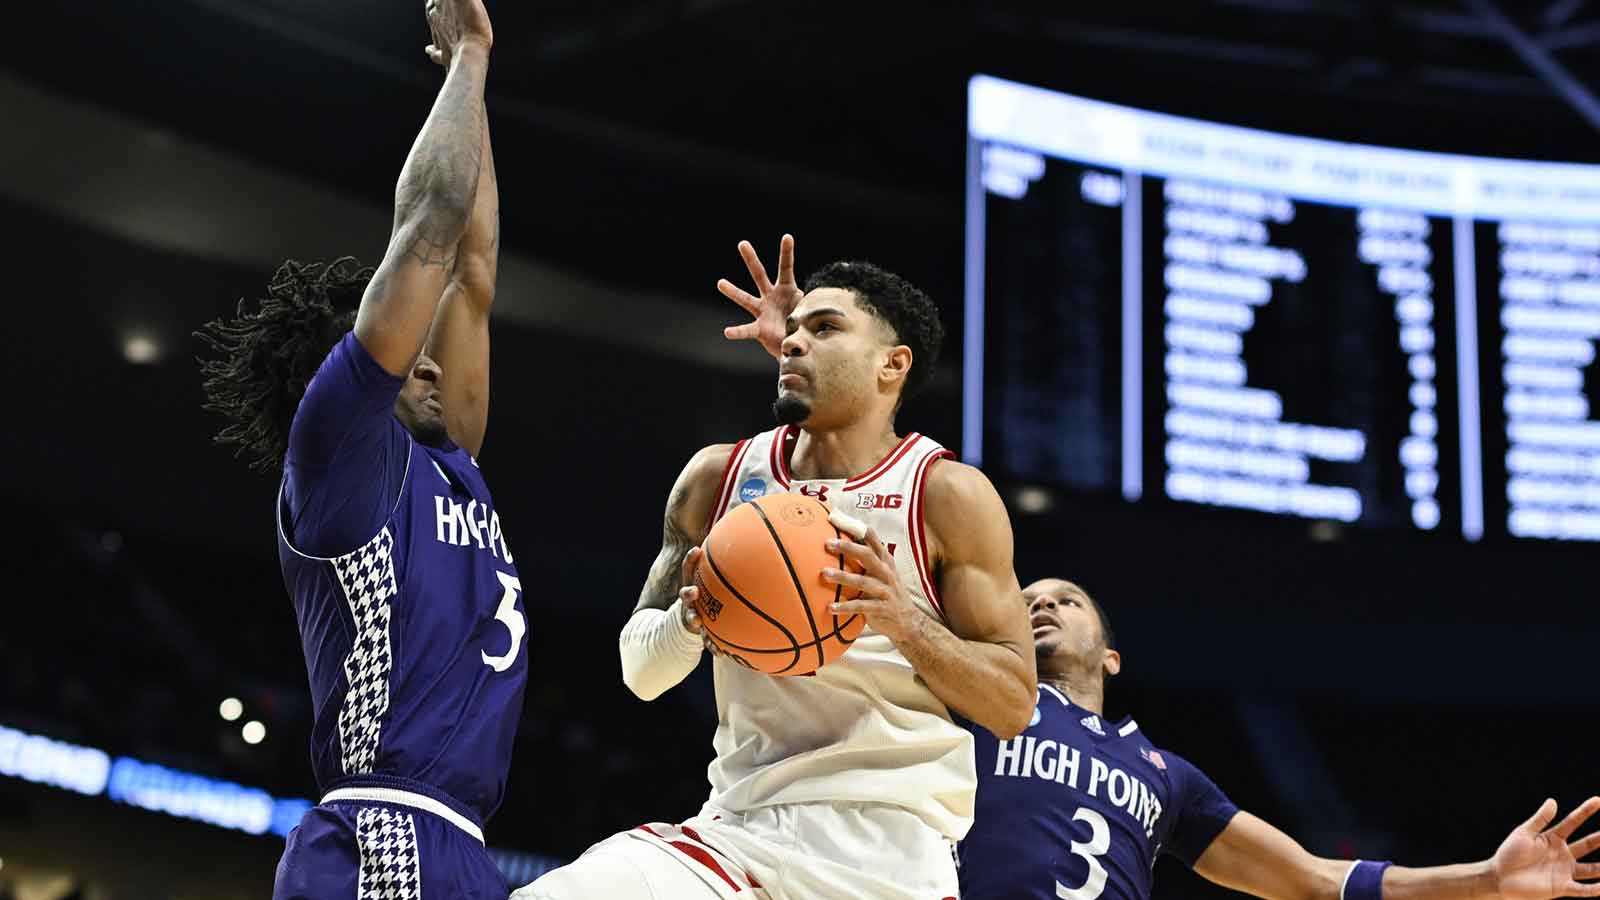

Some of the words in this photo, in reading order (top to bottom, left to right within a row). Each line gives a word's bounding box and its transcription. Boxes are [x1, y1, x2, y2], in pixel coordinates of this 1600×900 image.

[481, 570, 526, 673] 5
[994, 735, 1081, 789] HIGH
[1088, 757, 1162, 840] POINT
[1055, 807, 1111, 900] 3
